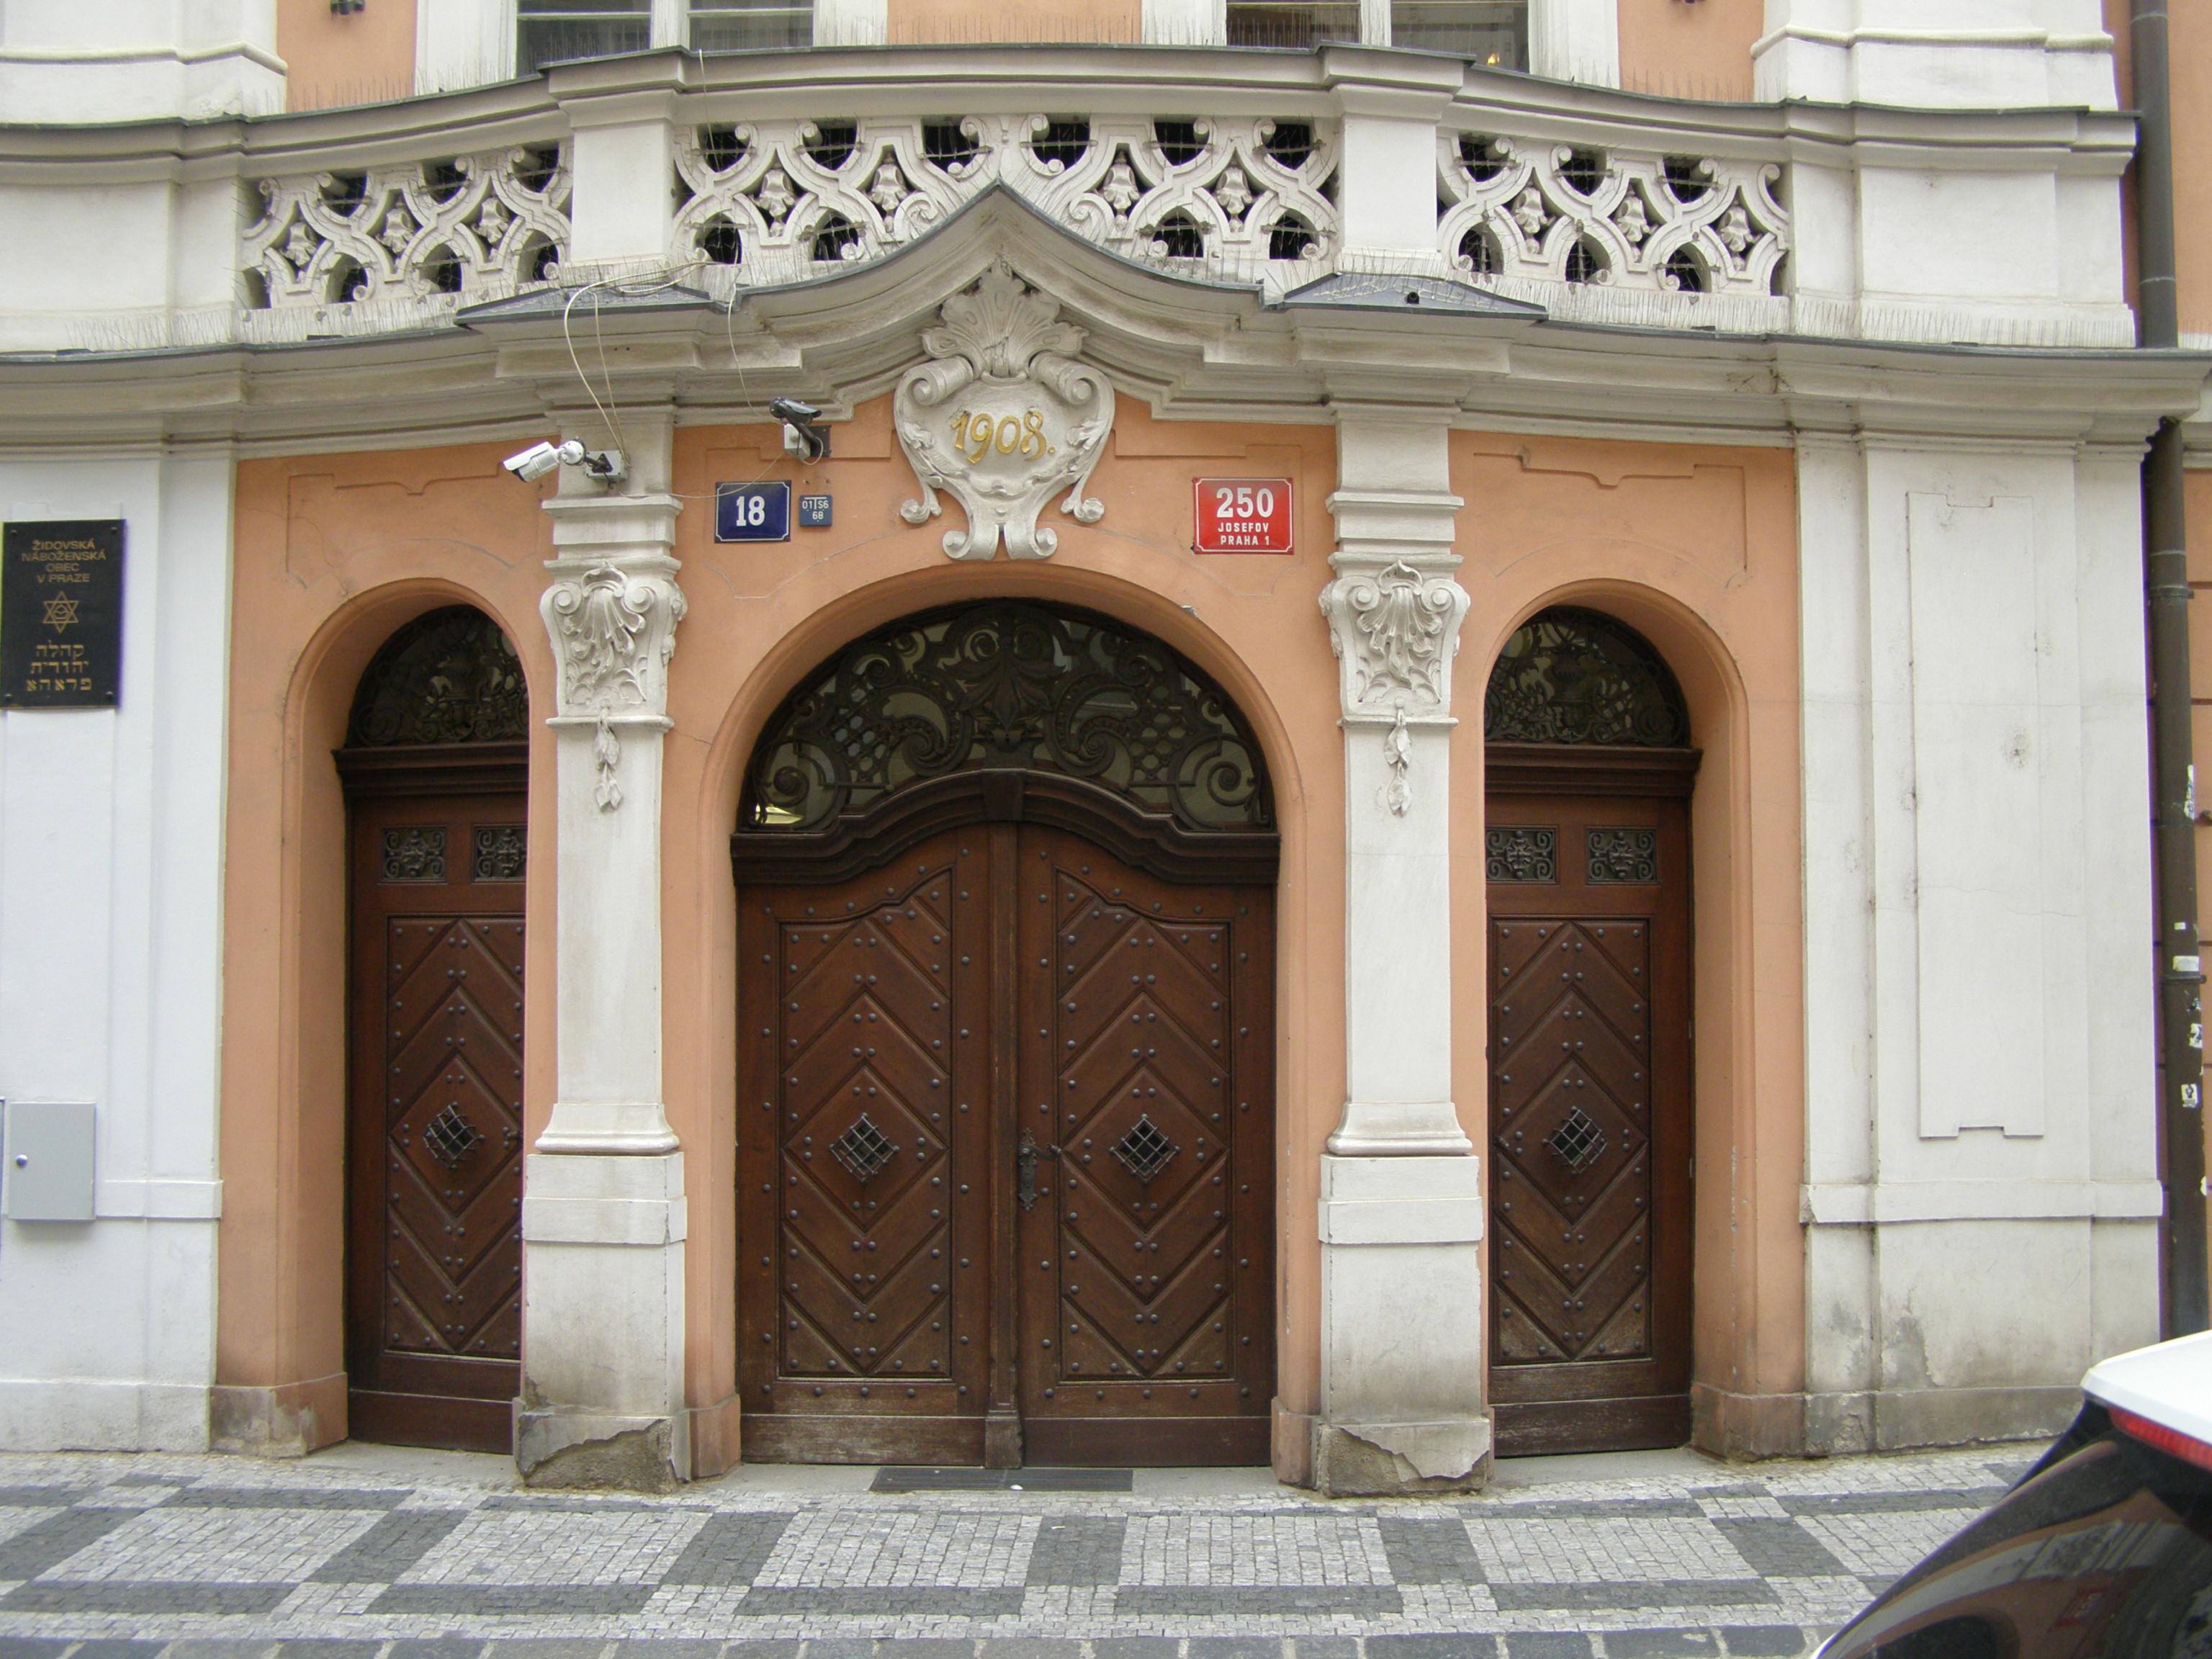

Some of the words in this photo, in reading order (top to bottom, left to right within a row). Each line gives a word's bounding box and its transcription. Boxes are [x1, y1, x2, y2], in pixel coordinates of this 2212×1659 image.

[1216, 487, 1274, 518] 250
[736, 495, 765, 526] 18
[1218, 522, 1269, 533] JOSEFOV
[32, 539, 95, 550] ŽIDOVSKÁ
[1220, 535, 1259, 546] PRAHA
[1264, 535, 1270, 546] 1
[22, 549, 106, 561] NÁBOŽENSKÁ
[45, 562, 80, 572] OBEC
[37, 575, 45, 583] V
[48, 573, 90, 583] PRAZE
